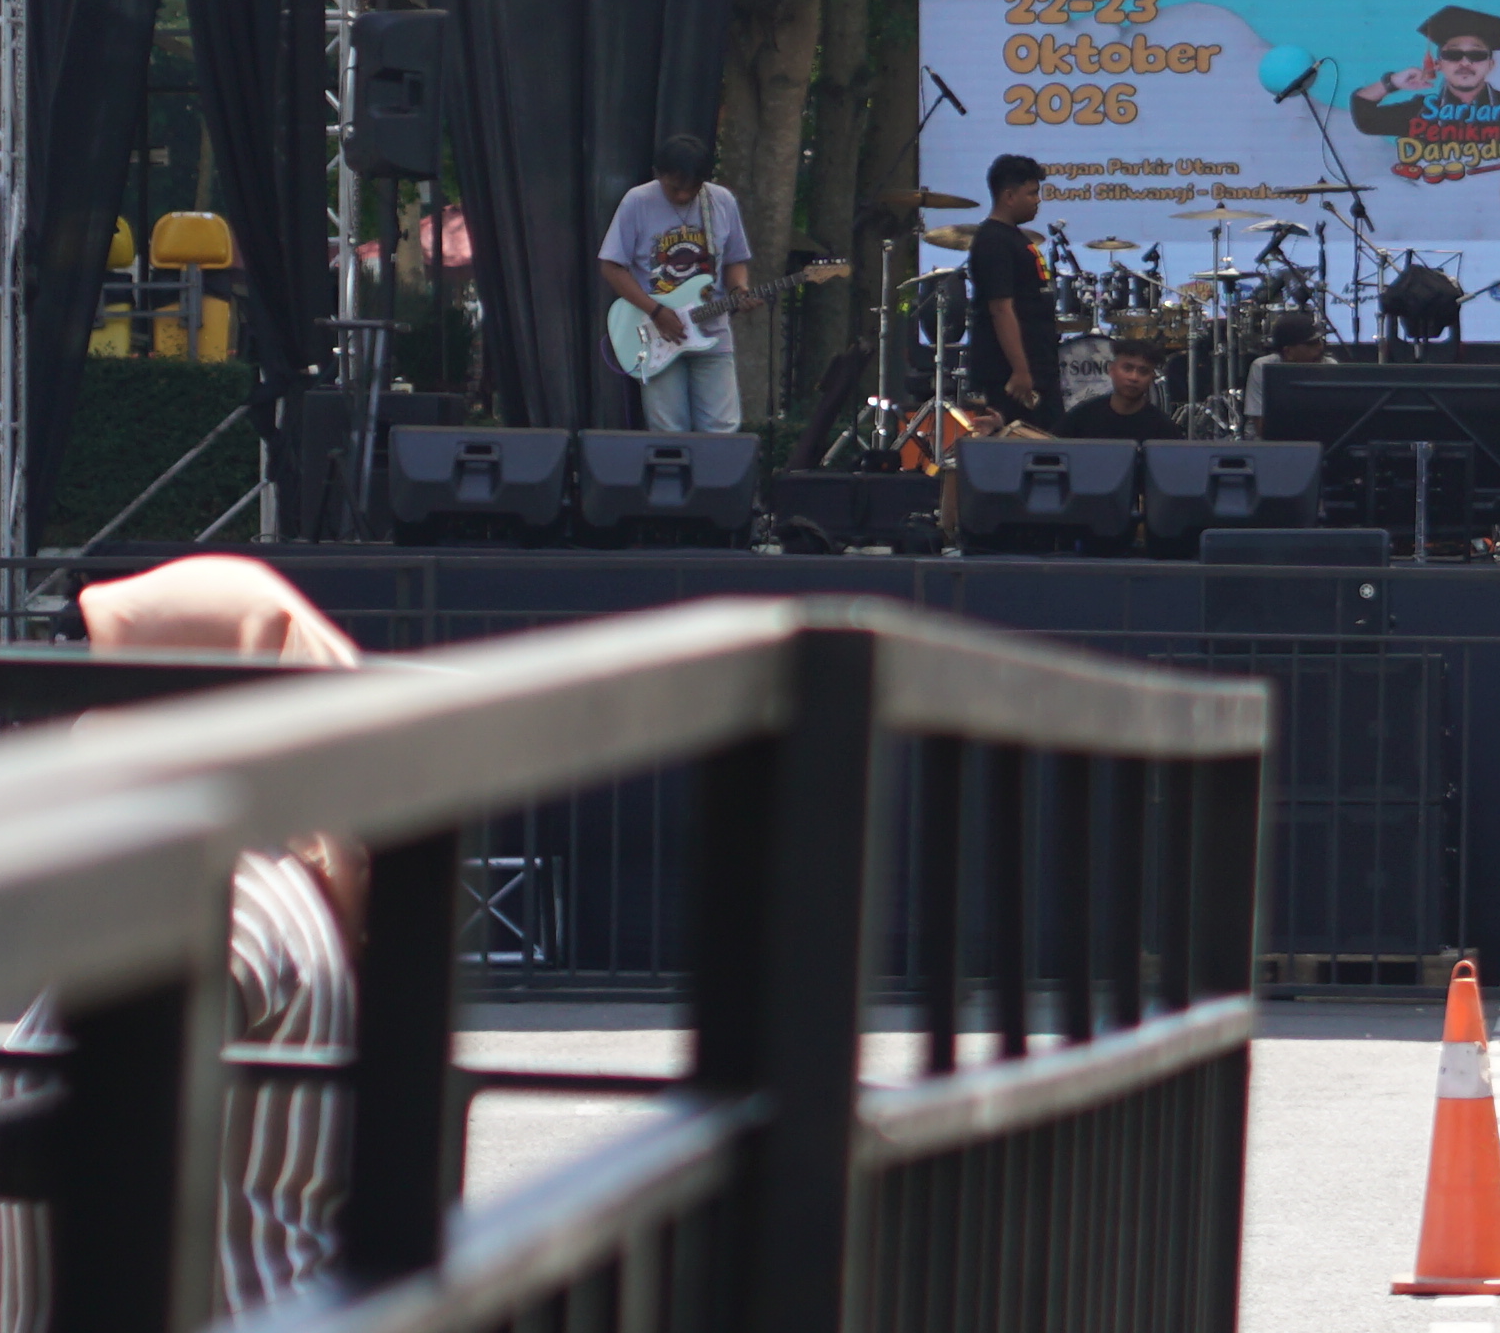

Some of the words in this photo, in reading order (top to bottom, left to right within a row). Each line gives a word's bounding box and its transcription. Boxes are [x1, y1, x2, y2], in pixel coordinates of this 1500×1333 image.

[1003, 33, 1222, 76] Oktober
[1003, 82, 1139, 126] 2026
[1106, 158, 1174, 176] Parkir
[1175, 158, 1240, 176] Utara
[1093, 183, 1197, 205] Siliwangi
